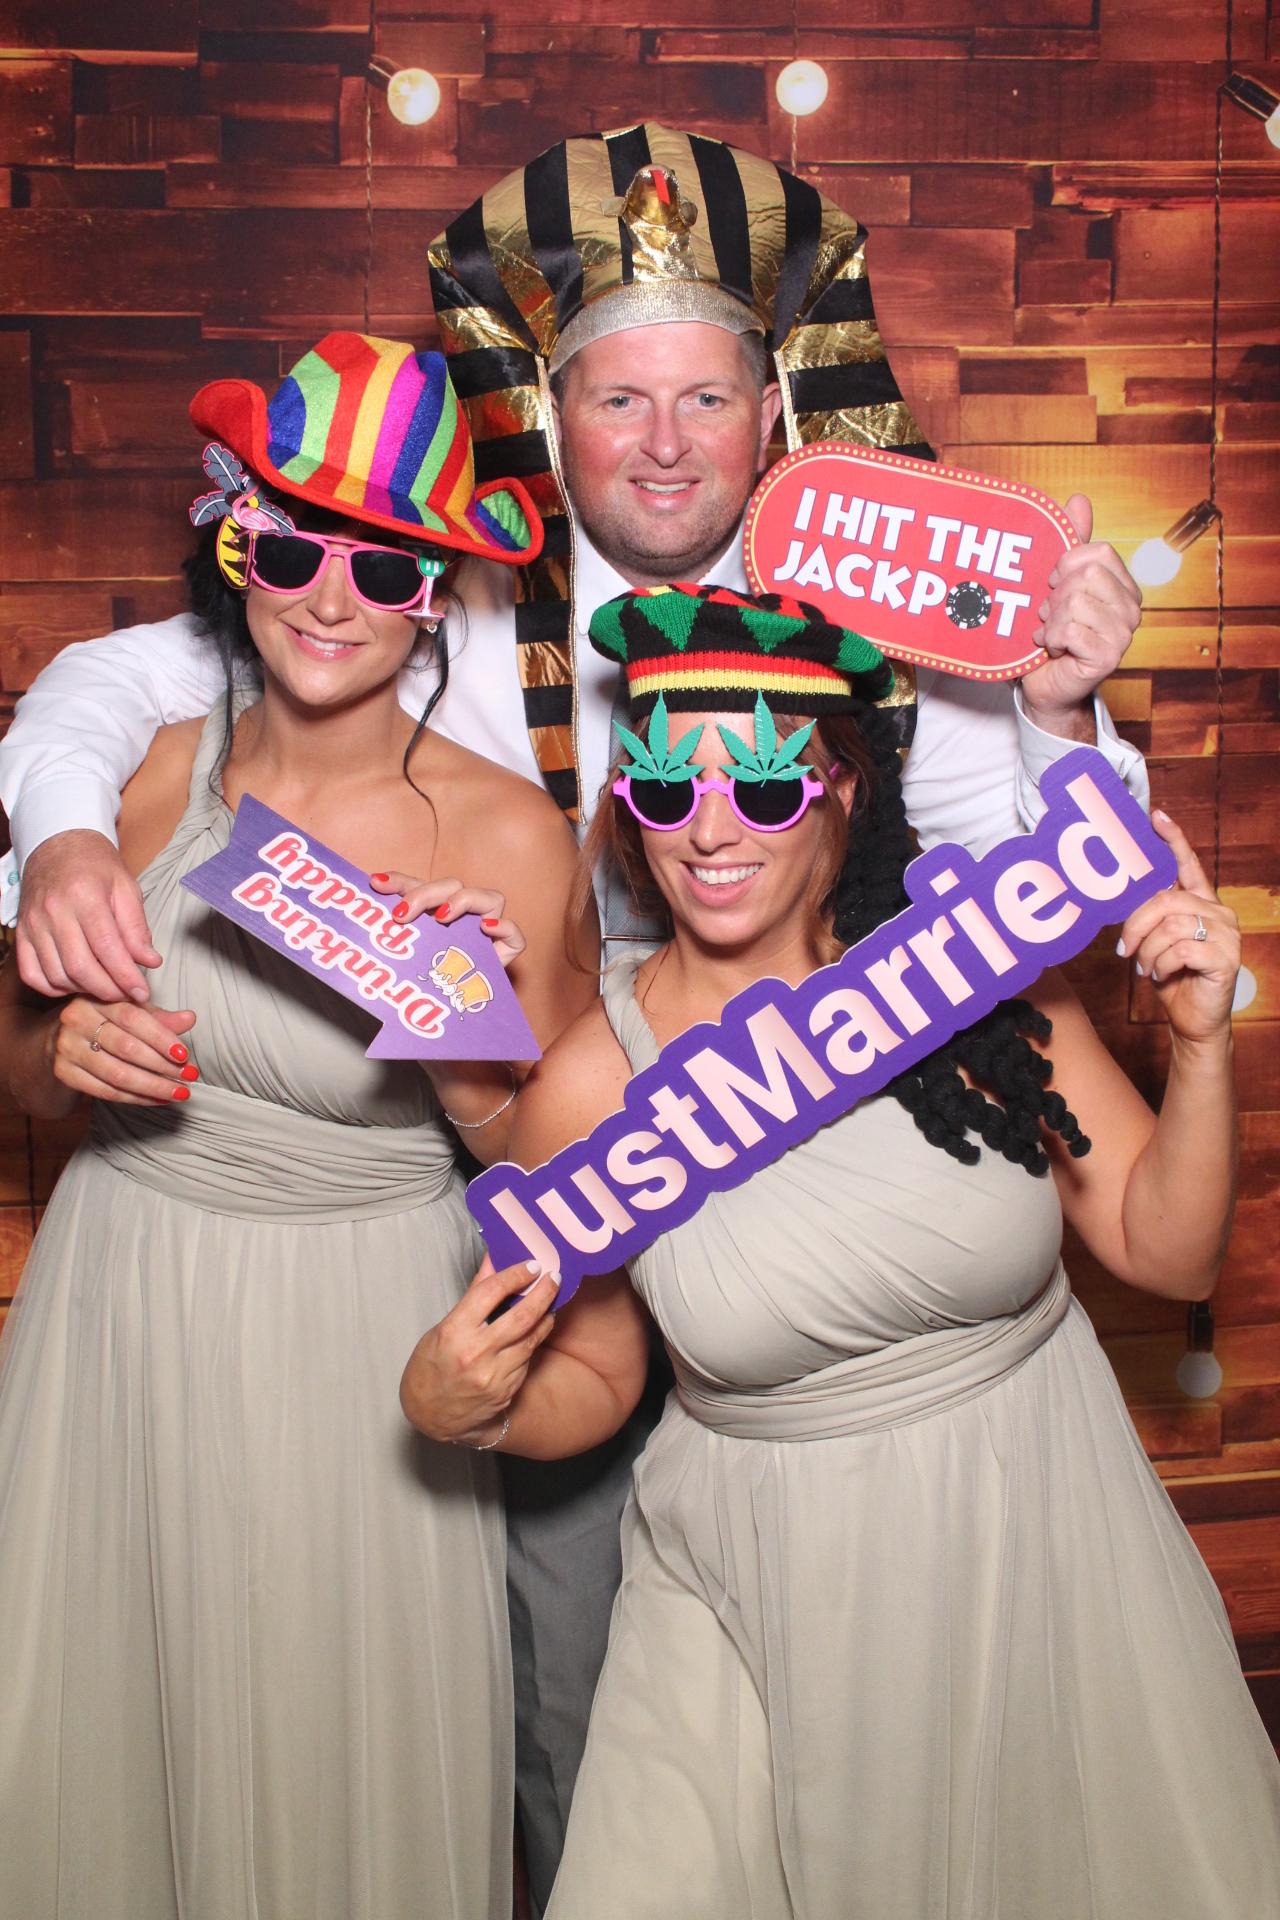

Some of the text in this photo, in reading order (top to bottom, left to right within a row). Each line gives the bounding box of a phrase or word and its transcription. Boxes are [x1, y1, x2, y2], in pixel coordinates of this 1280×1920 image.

[773, 540, 1031, 637] JACKPOT
[794, 488, 1033, 582] I HIT THE
[262, 834, 417, 957] Buddy
[236, 875, 447, 1036] Drinking
